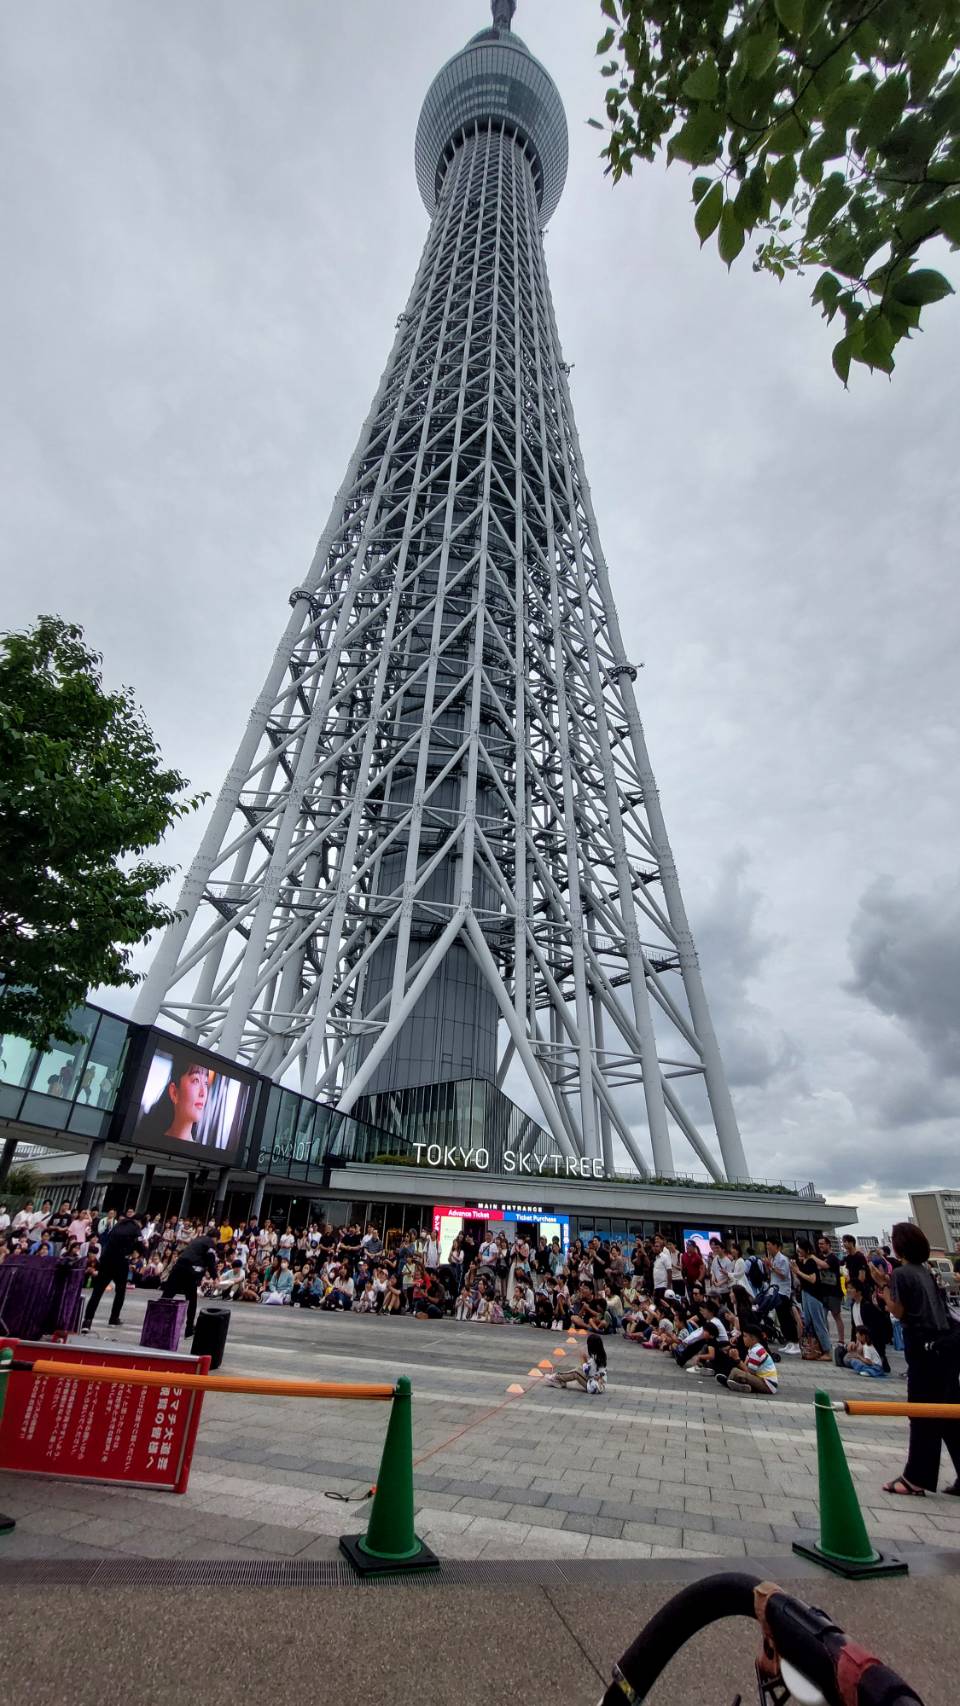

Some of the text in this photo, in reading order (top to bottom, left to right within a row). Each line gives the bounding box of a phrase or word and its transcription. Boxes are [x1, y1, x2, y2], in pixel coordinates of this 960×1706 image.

[413, 1143, 489, 1169] TOKYO
[502, 1204, 543, 1213] ENTRANCE
[448, 1209, 490, 1219] Advance Ticket
[516, 1213, 557, 1223] Ticket Purchase
[157, 1386, 183, 1471] ラマチ大道芸
